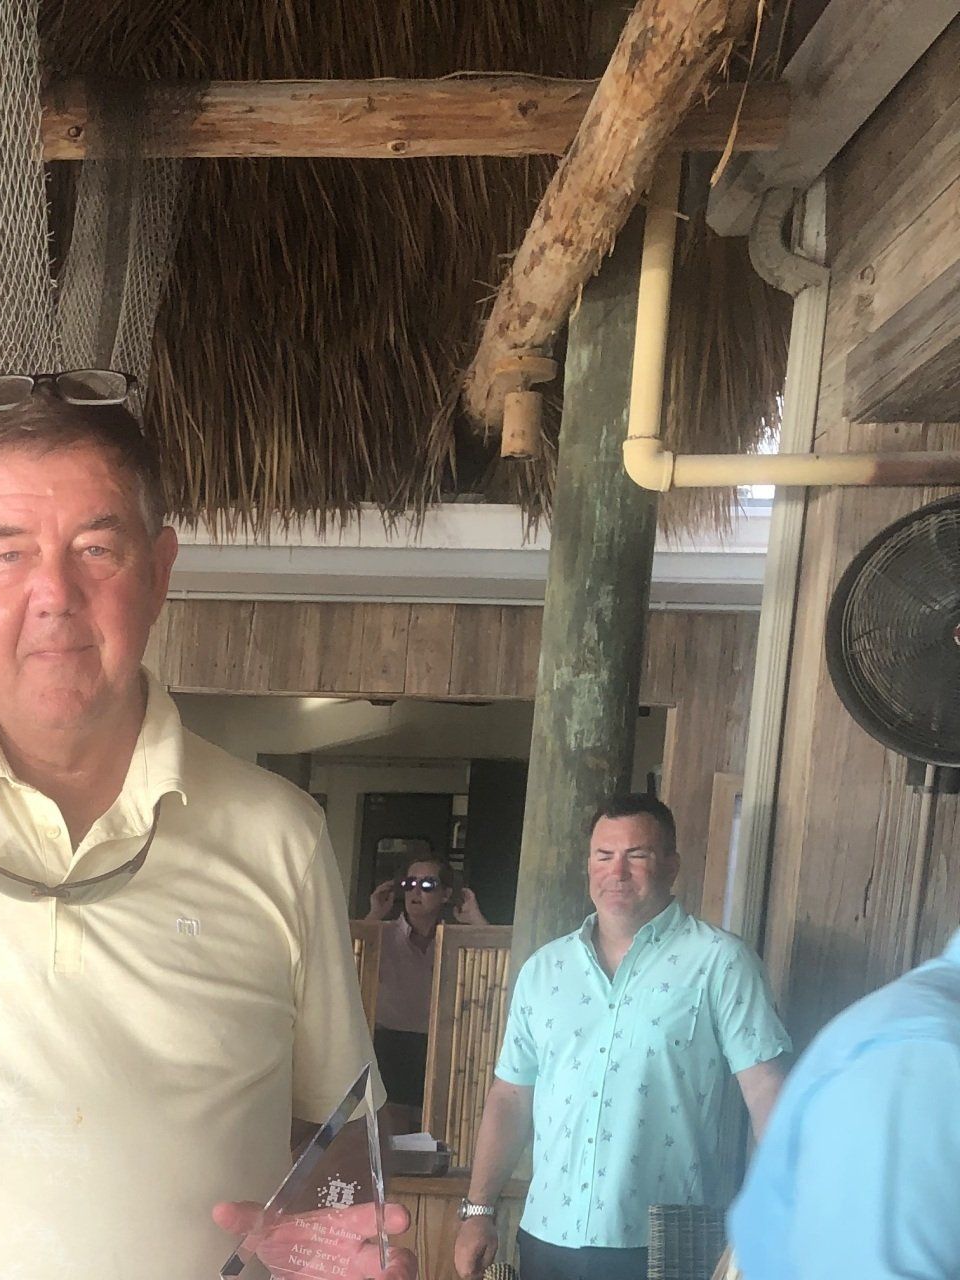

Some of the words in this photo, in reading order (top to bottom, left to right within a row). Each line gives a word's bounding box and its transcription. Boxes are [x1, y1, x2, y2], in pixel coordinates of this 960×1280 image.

[295, 1218, 311, 1228] The
[312, 1222, 327, 1235] Big
[329, 1226, 362, 1241] Kahuna
[311, 1234, 339, 1246] Award
[291, 1243, 312, 1255] Aire
[331, 1264, 348, 1277] DE
